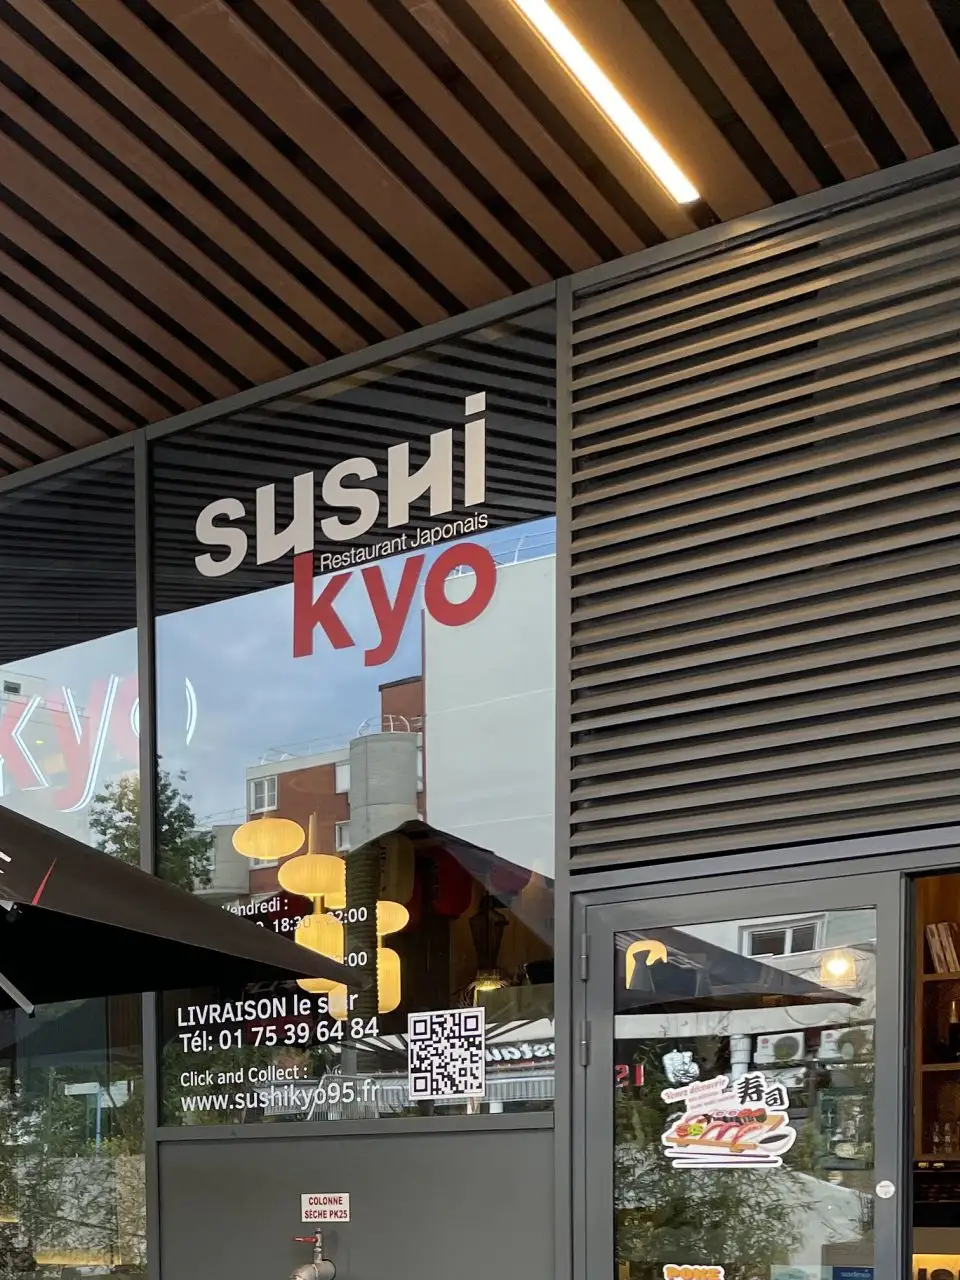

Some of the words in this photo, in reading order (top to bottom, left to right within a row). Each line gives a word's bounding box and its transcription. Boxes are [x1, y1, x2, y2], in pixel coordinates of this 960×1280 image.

[320, 534, 407, 572] Restaurant
[410, 511, 488, 548] Japonais
[293, 542, 497, 667] kyo
[344, 951, 368, 967] :00
[177, 997, 286, 1027] LIVRAISON
[293, 994, 311, 1016] le
[317, 993, 359, 1014] sr
[179, 1030, 213, 1053] Tél:
[218, 1029, 242, 1050] 01
[251, 1026, 277, 1047] 75
[283, 1022, 310, 1045] 39
[316, 1020, 344, 1042] 64
[350, 1016, 379, 1039] 84
[180, 1070, 214, 1087] Click
[217, 1068, 244, 1085] and
[248, 1065, 300, 1082] Collect
[737, 1075, 786, 1107] 寿司
[180, 1079, 380, 1111] www.sushikyo95.fr
[308, 1196, 343, 1206] COLONNE
[329, 1209, 348, 1219] PK25
